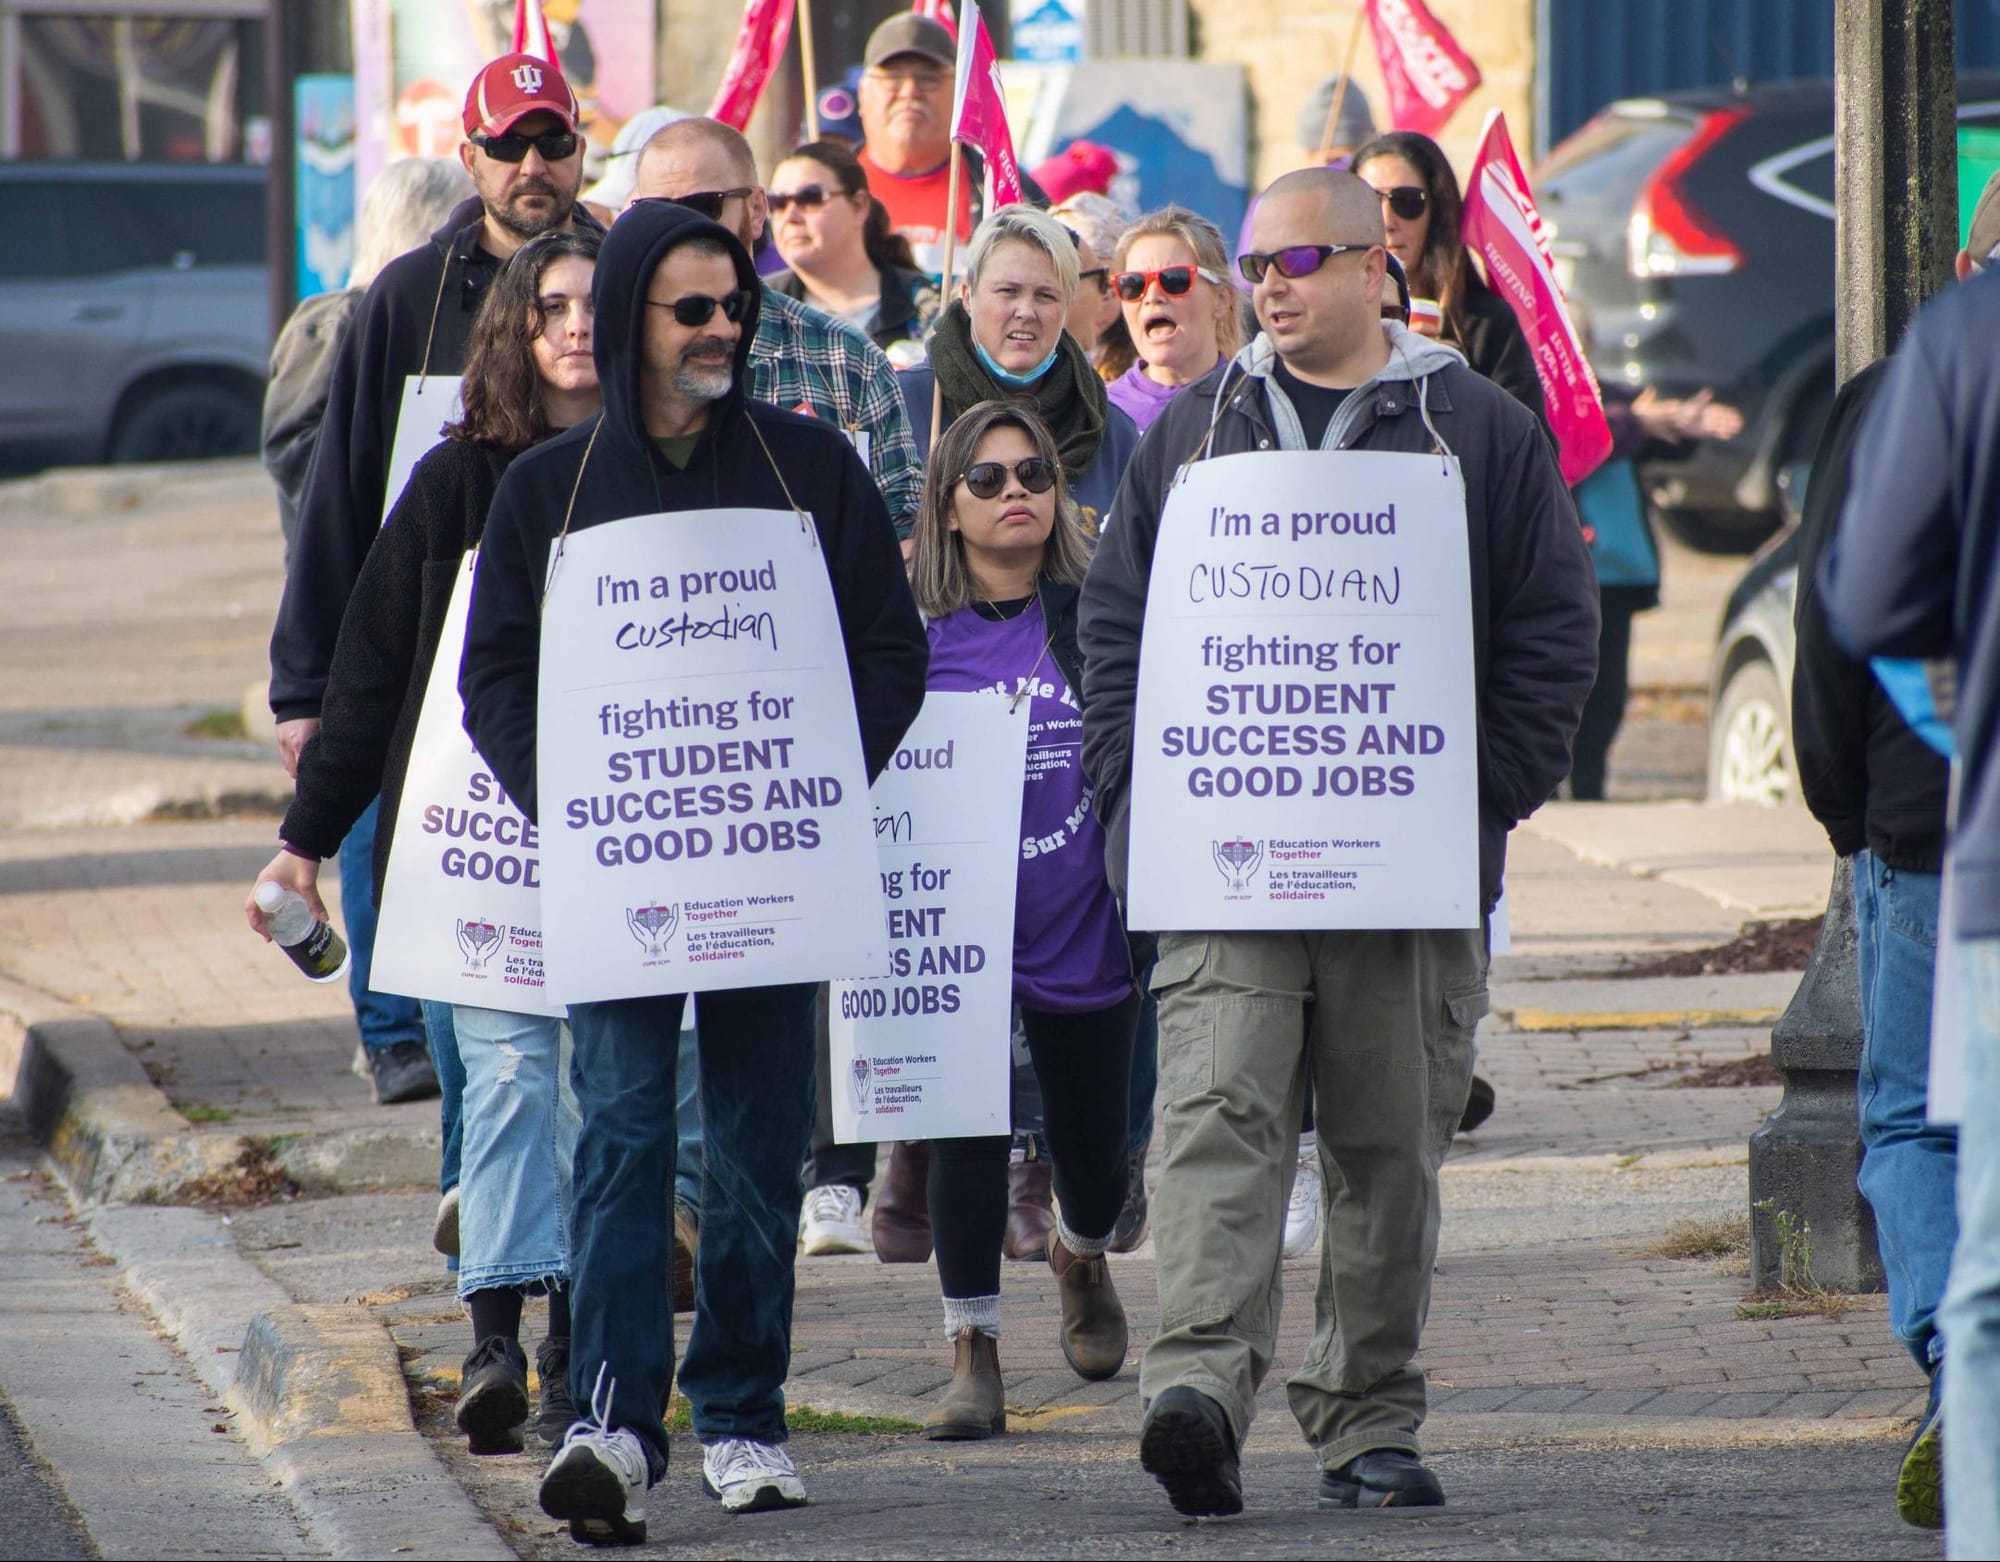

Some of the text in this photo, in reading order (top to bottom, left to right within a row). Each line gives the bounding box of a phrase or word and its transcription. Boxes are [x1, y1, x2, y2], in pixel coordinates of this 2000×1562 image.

[1211, 504, 1395, 541] I'm a proud
[598, 560, 776, 606] I'm a proud
[1190, 563, 1400, 605] CUSTODIAN
[616, 603, 777, 651] custodian
[1202, 635, 1400, 672] fighting for
[1016, 677, 1055, 699] Me
[1207, 684, 1395, 715] STUDENT
[599, 691, 794, 738] fighting for
[1046, 718, 1082, 730] Worke
[885, 740, 954, 770] oud
[1162, 725, 1445, 757] SUCCESS AND
[608, 738, 794, 783] STUDENT
[1188, 766, 1414, 797] GOOD JOBS
[566, 777, 842, 829] SUCCESS AND
[422, 805, 539, 849] SUCCE
[596, 819, 820, 866] GOOD JOBS
[1023, 829, 1067, 859] Sur
[1270, 840, 1380, 848] Education Workers
[1270, 850, 1321, 860] Together
[441, 847, 540, 888] GOOD
[910, 863, 951, 891] for
[1270, 870, 1357, 879] Les travailleurs
[1269, 880, 1355, 890] de l'éducation,
[1270, 891, 1325, 899] solidaires
[685, 895, 794, 910] Education Workers
[685, 910, 737, 921] Together
[687, 928, 775, 941] Les travailleurs
[886, 907, 946, 939] ENT
[688, 938, 774, 951] de l'éducation,
[689, 951, 744, 962] solidaires
[505, 965, 519, 974] de
[506, 954, 525, 965] Les
[918, 945, 985, 976] AND
[842, 984, 960, 1019] GOOD JOBS
[873, 1057, 903, 1066] Education
[873, 1066, 900, 1076] Together
[875, 1085, 922, 1094] Les travailleurs
[883, 1095, 922, 1103] l'éducation,
[875, 1105, 904, 1114] solidaires
